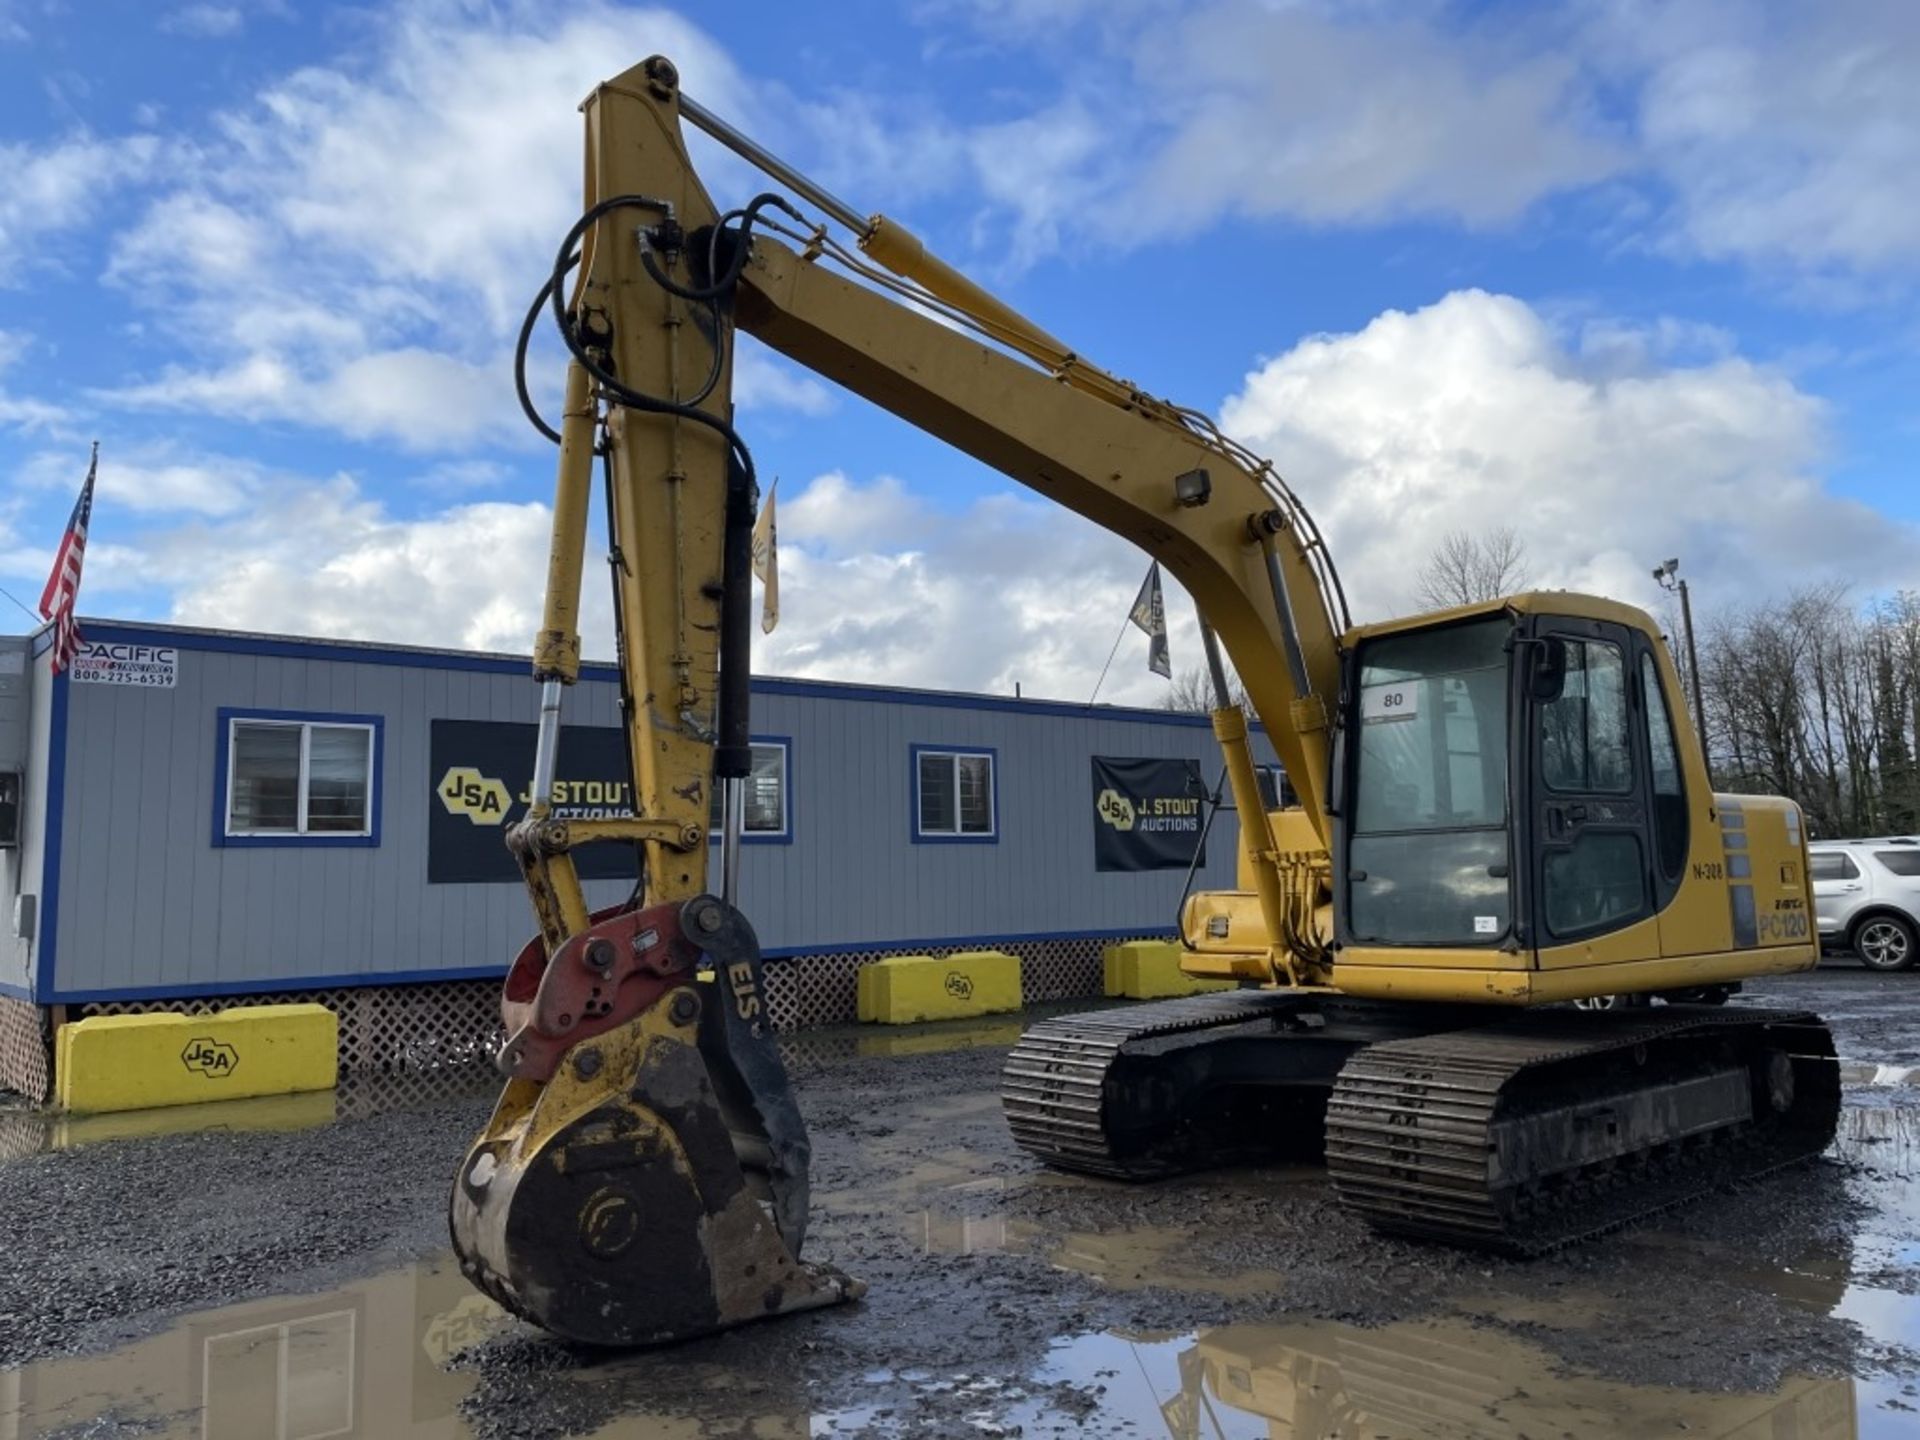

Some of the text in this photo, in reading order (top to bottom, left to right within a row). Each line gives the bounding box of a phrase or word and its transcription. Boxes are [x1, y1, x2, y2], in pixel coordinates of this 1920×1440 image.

[75, 644, 174, 664] PACIFIC
[74, 669, 173, 685] 800-225-6539
[1383, 692, 1403, 707] 80
[446, 775, 500, 813] JSA
[1101, 795, 1131, 822] JSA
[1138, 798, 1199, 815] J. STOUT
[1140, 818, 1197, 832] AUCTIONS
[1759, 913, 1807, 940] PC120
[948, 976, 969, 995] JSA
[187, 1043, 229, 1070] JSA
